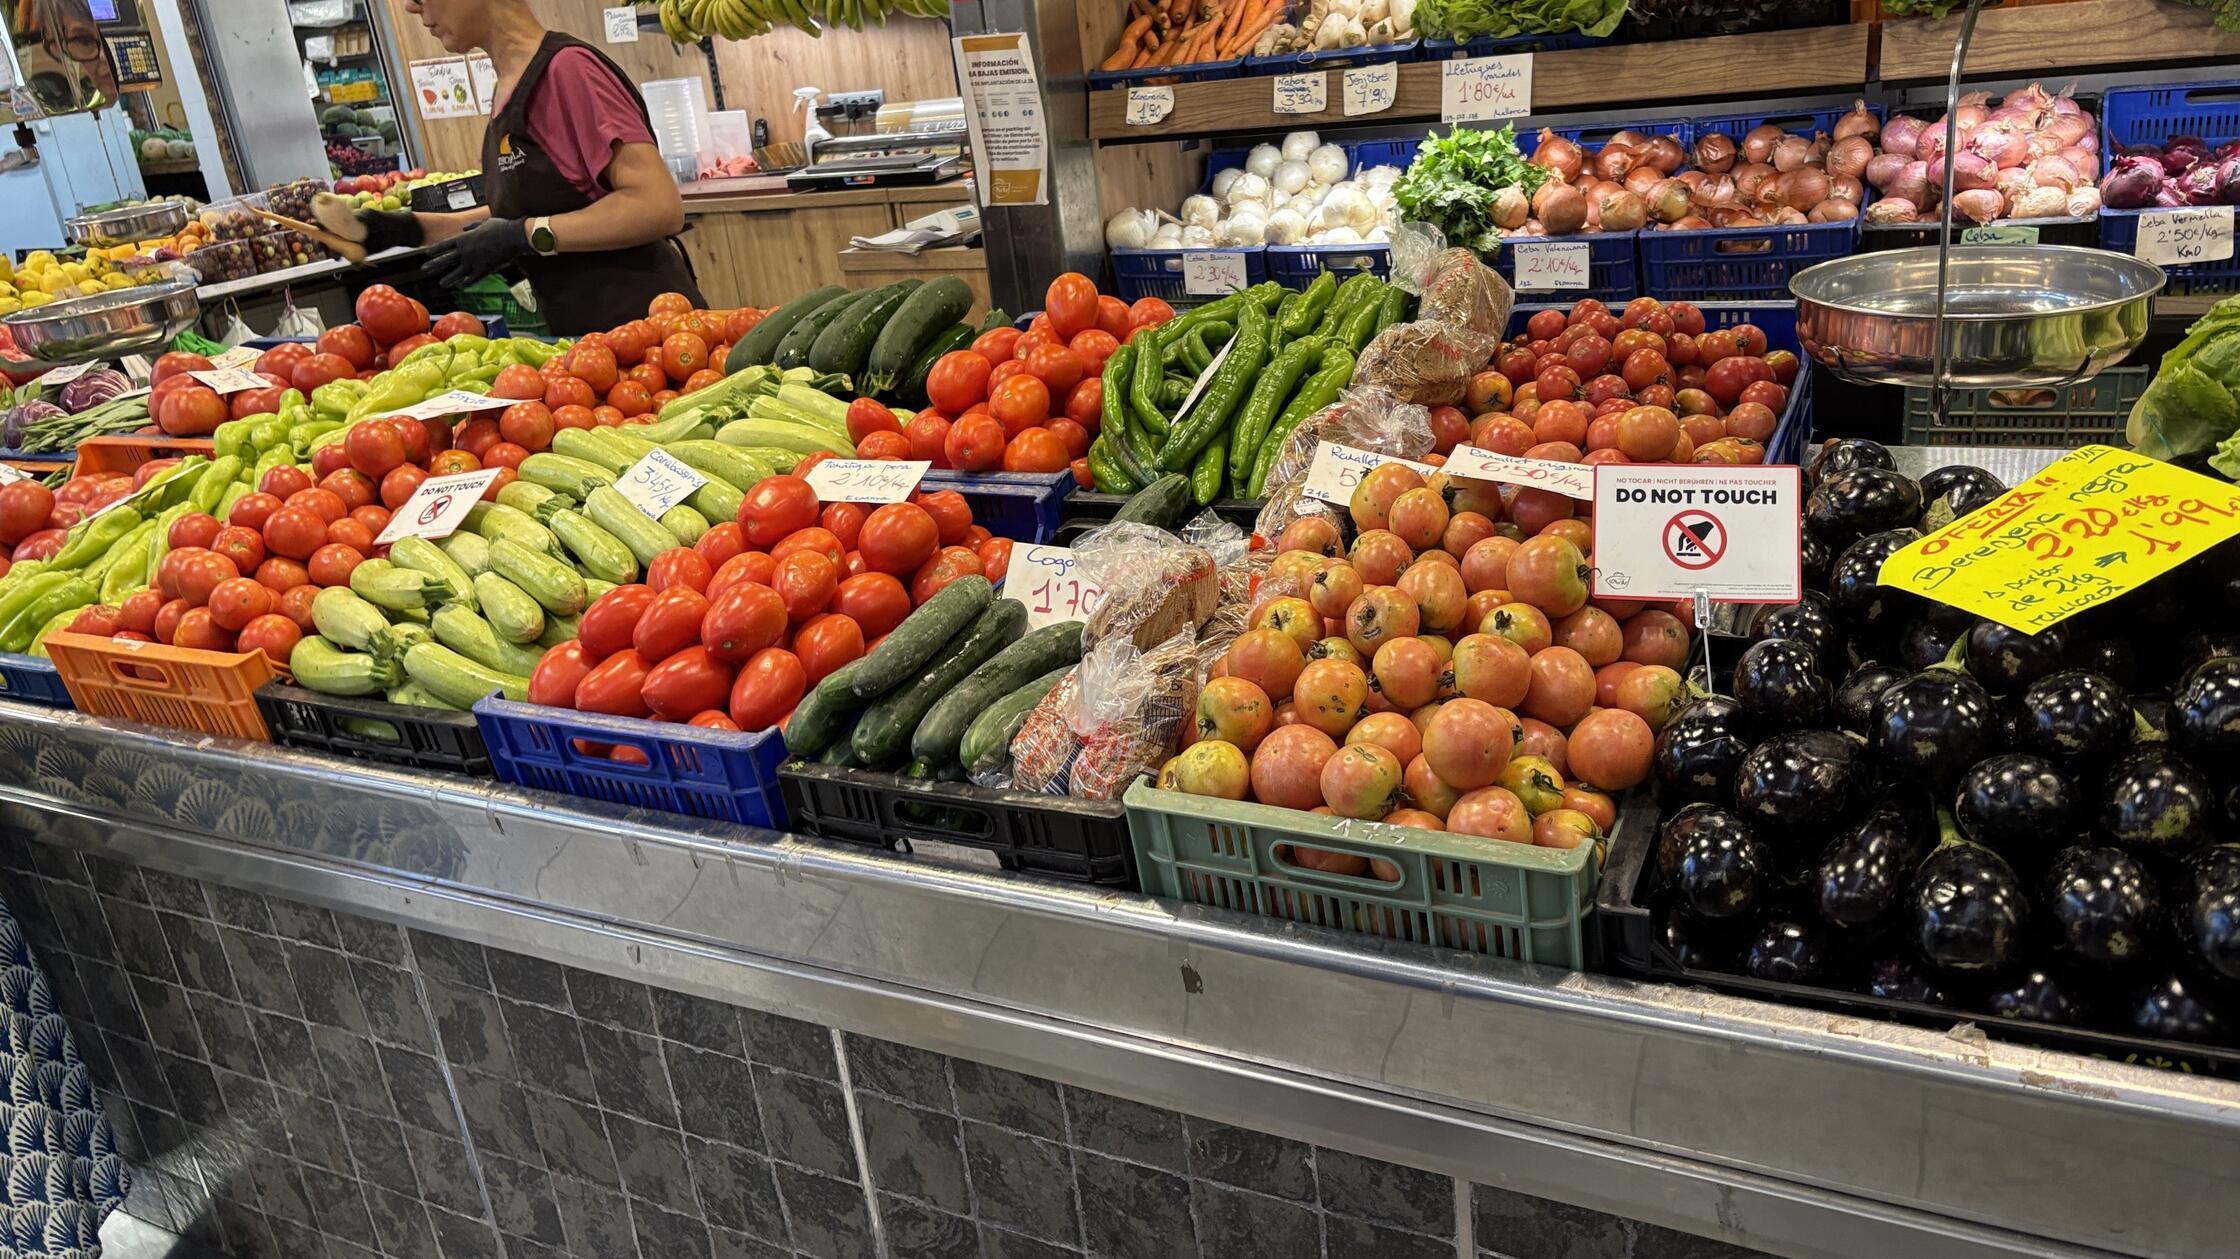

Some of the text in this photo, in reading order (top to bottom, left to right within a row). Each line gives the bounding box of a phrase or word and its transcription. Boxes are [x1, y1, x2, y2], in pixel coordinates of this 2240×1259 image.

[971, 58, 1019, 68] INFORMACIÓN
[999, 68, 1030, 76] EMISION
[2140, 216, 2166, 228] Ceba
[1518, 245, 1540, 253] Ceba
[421, 488, 434, 497] DO
[433, 485, 455, 494] NOT
[453, 480, 486, 491] TOUCH
[1616, 488, 1777, 505] DO NOT TOUCH
